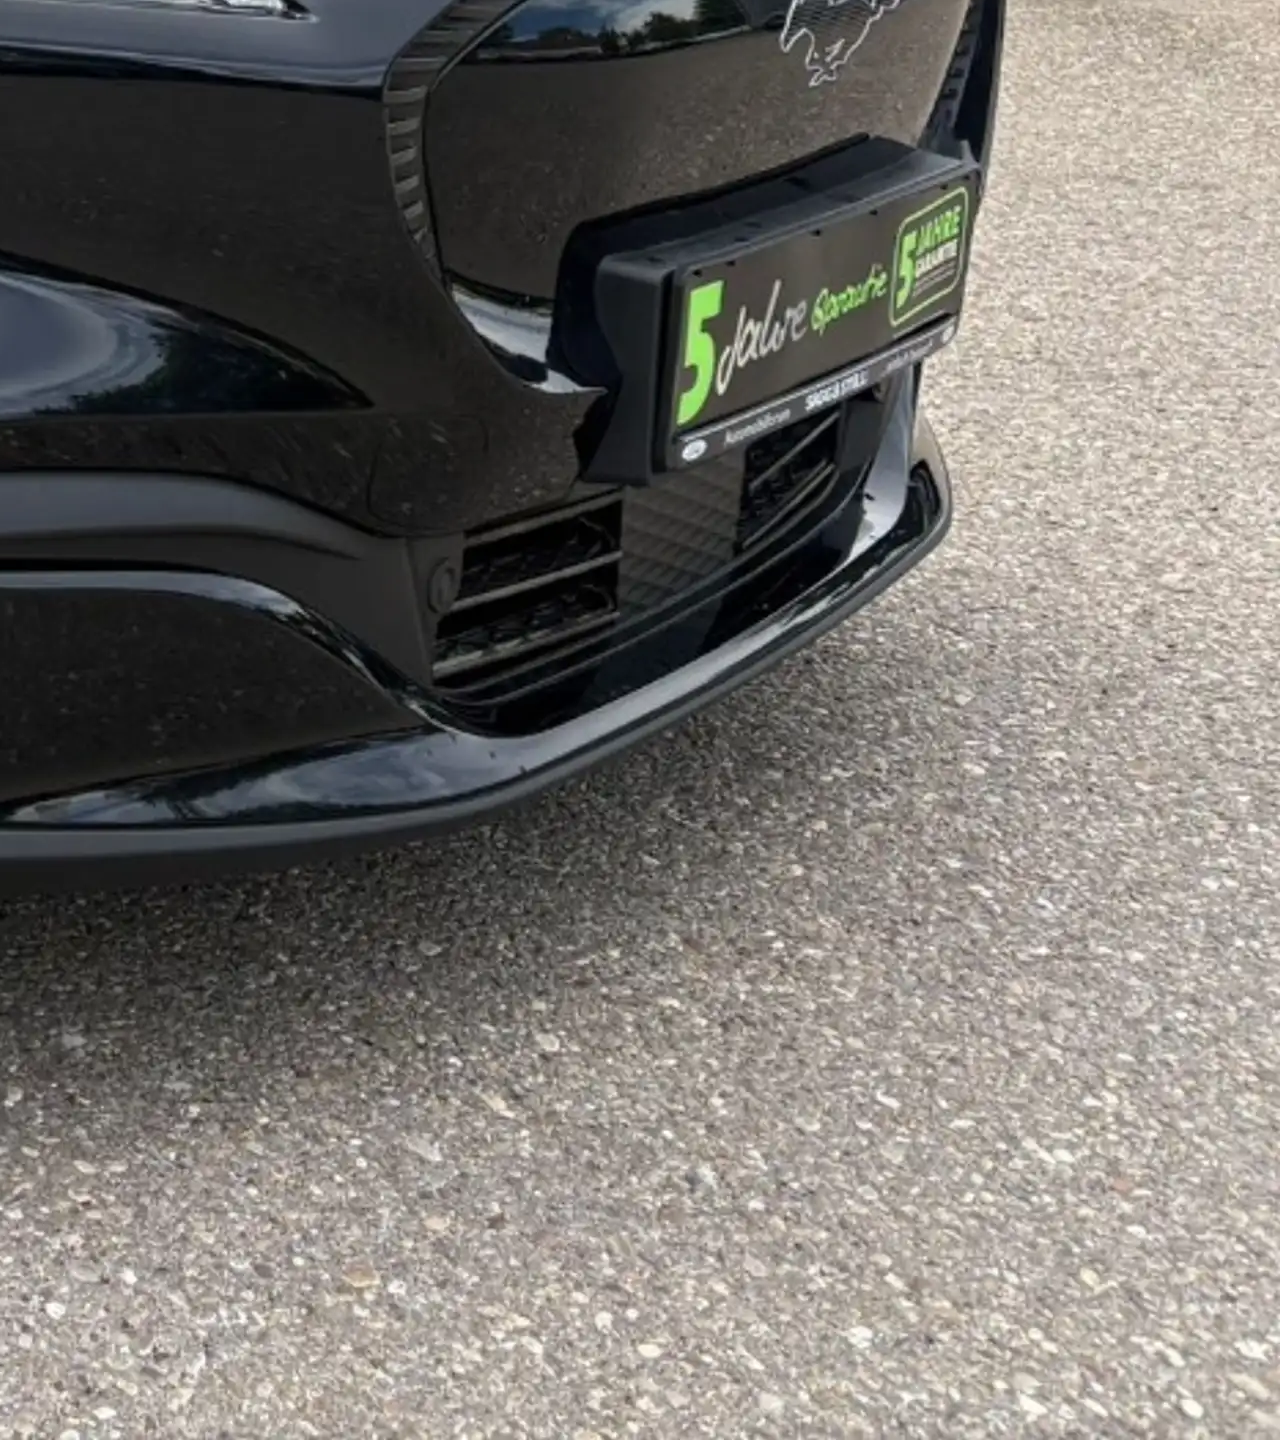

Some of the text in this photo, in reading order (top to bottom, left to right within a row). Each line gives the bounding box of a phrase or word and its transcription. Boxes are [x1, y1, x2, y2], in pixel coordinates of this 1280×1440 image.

[896, 229, 917, 309] 5
[676, 279, 724, 426] 5
[716, 279, 808, 397] Jahre
